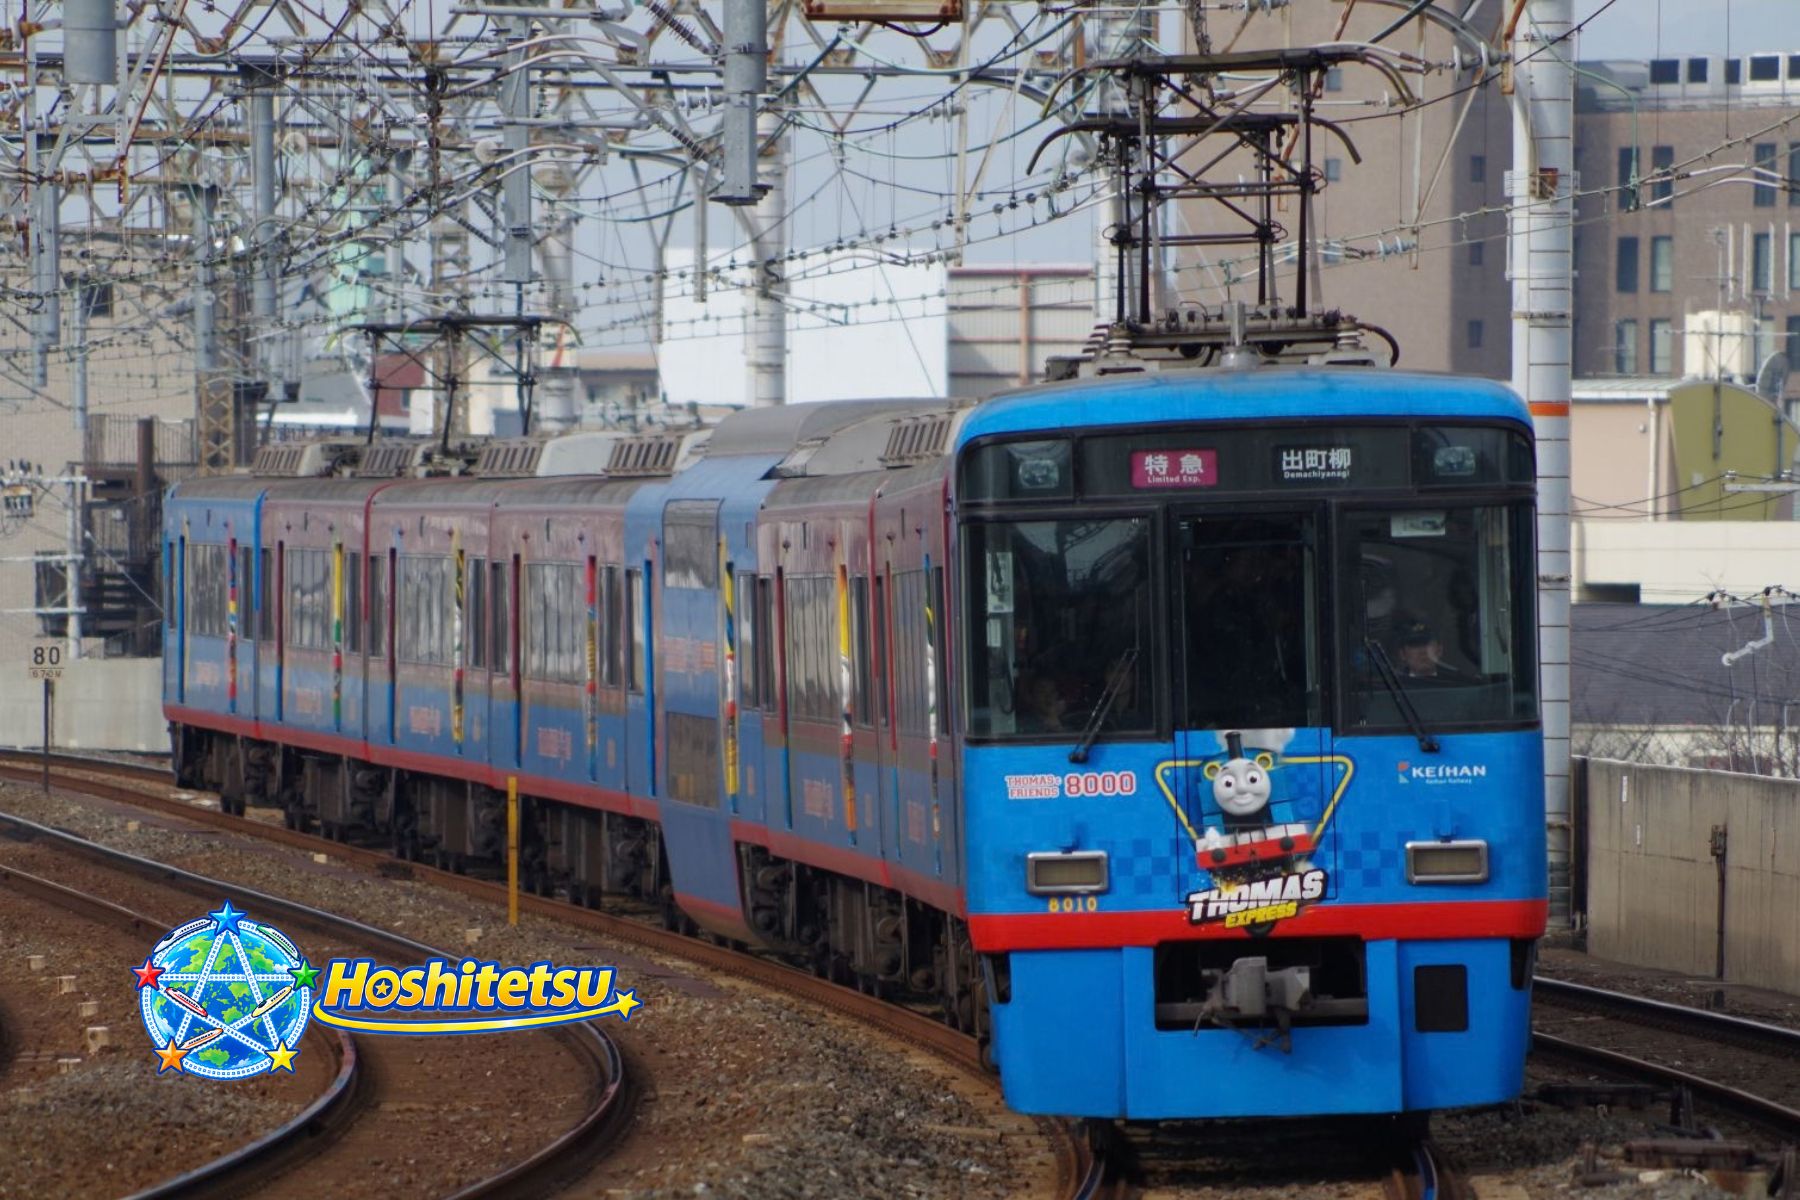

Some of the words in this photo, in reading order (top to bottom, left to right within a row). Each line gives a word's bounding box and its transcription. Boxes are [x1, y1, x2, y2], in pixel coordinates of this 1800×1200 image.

[1144, 453, 1204, 476] 特急
[1282, 447, 1352, 471] 出町柳
[1147, 475, 1180, 484] Limited
[1283, 470, 1350, 479] Demachiyanagi
[33, 646, 60, 665] 80
[1006, 774, 1055, 787] THOMAS
[1412, 764, 1486, 779] KEIHAN
[1008, 786, 1059, 799] FRIENDS
[1065, 771, 1136, 797] 8000
[1188, 869, 1325, 921] THOMAS
[1049, 896, 1097, 913] 8010
[1225, 901, 1299, 929] EXPRESS
